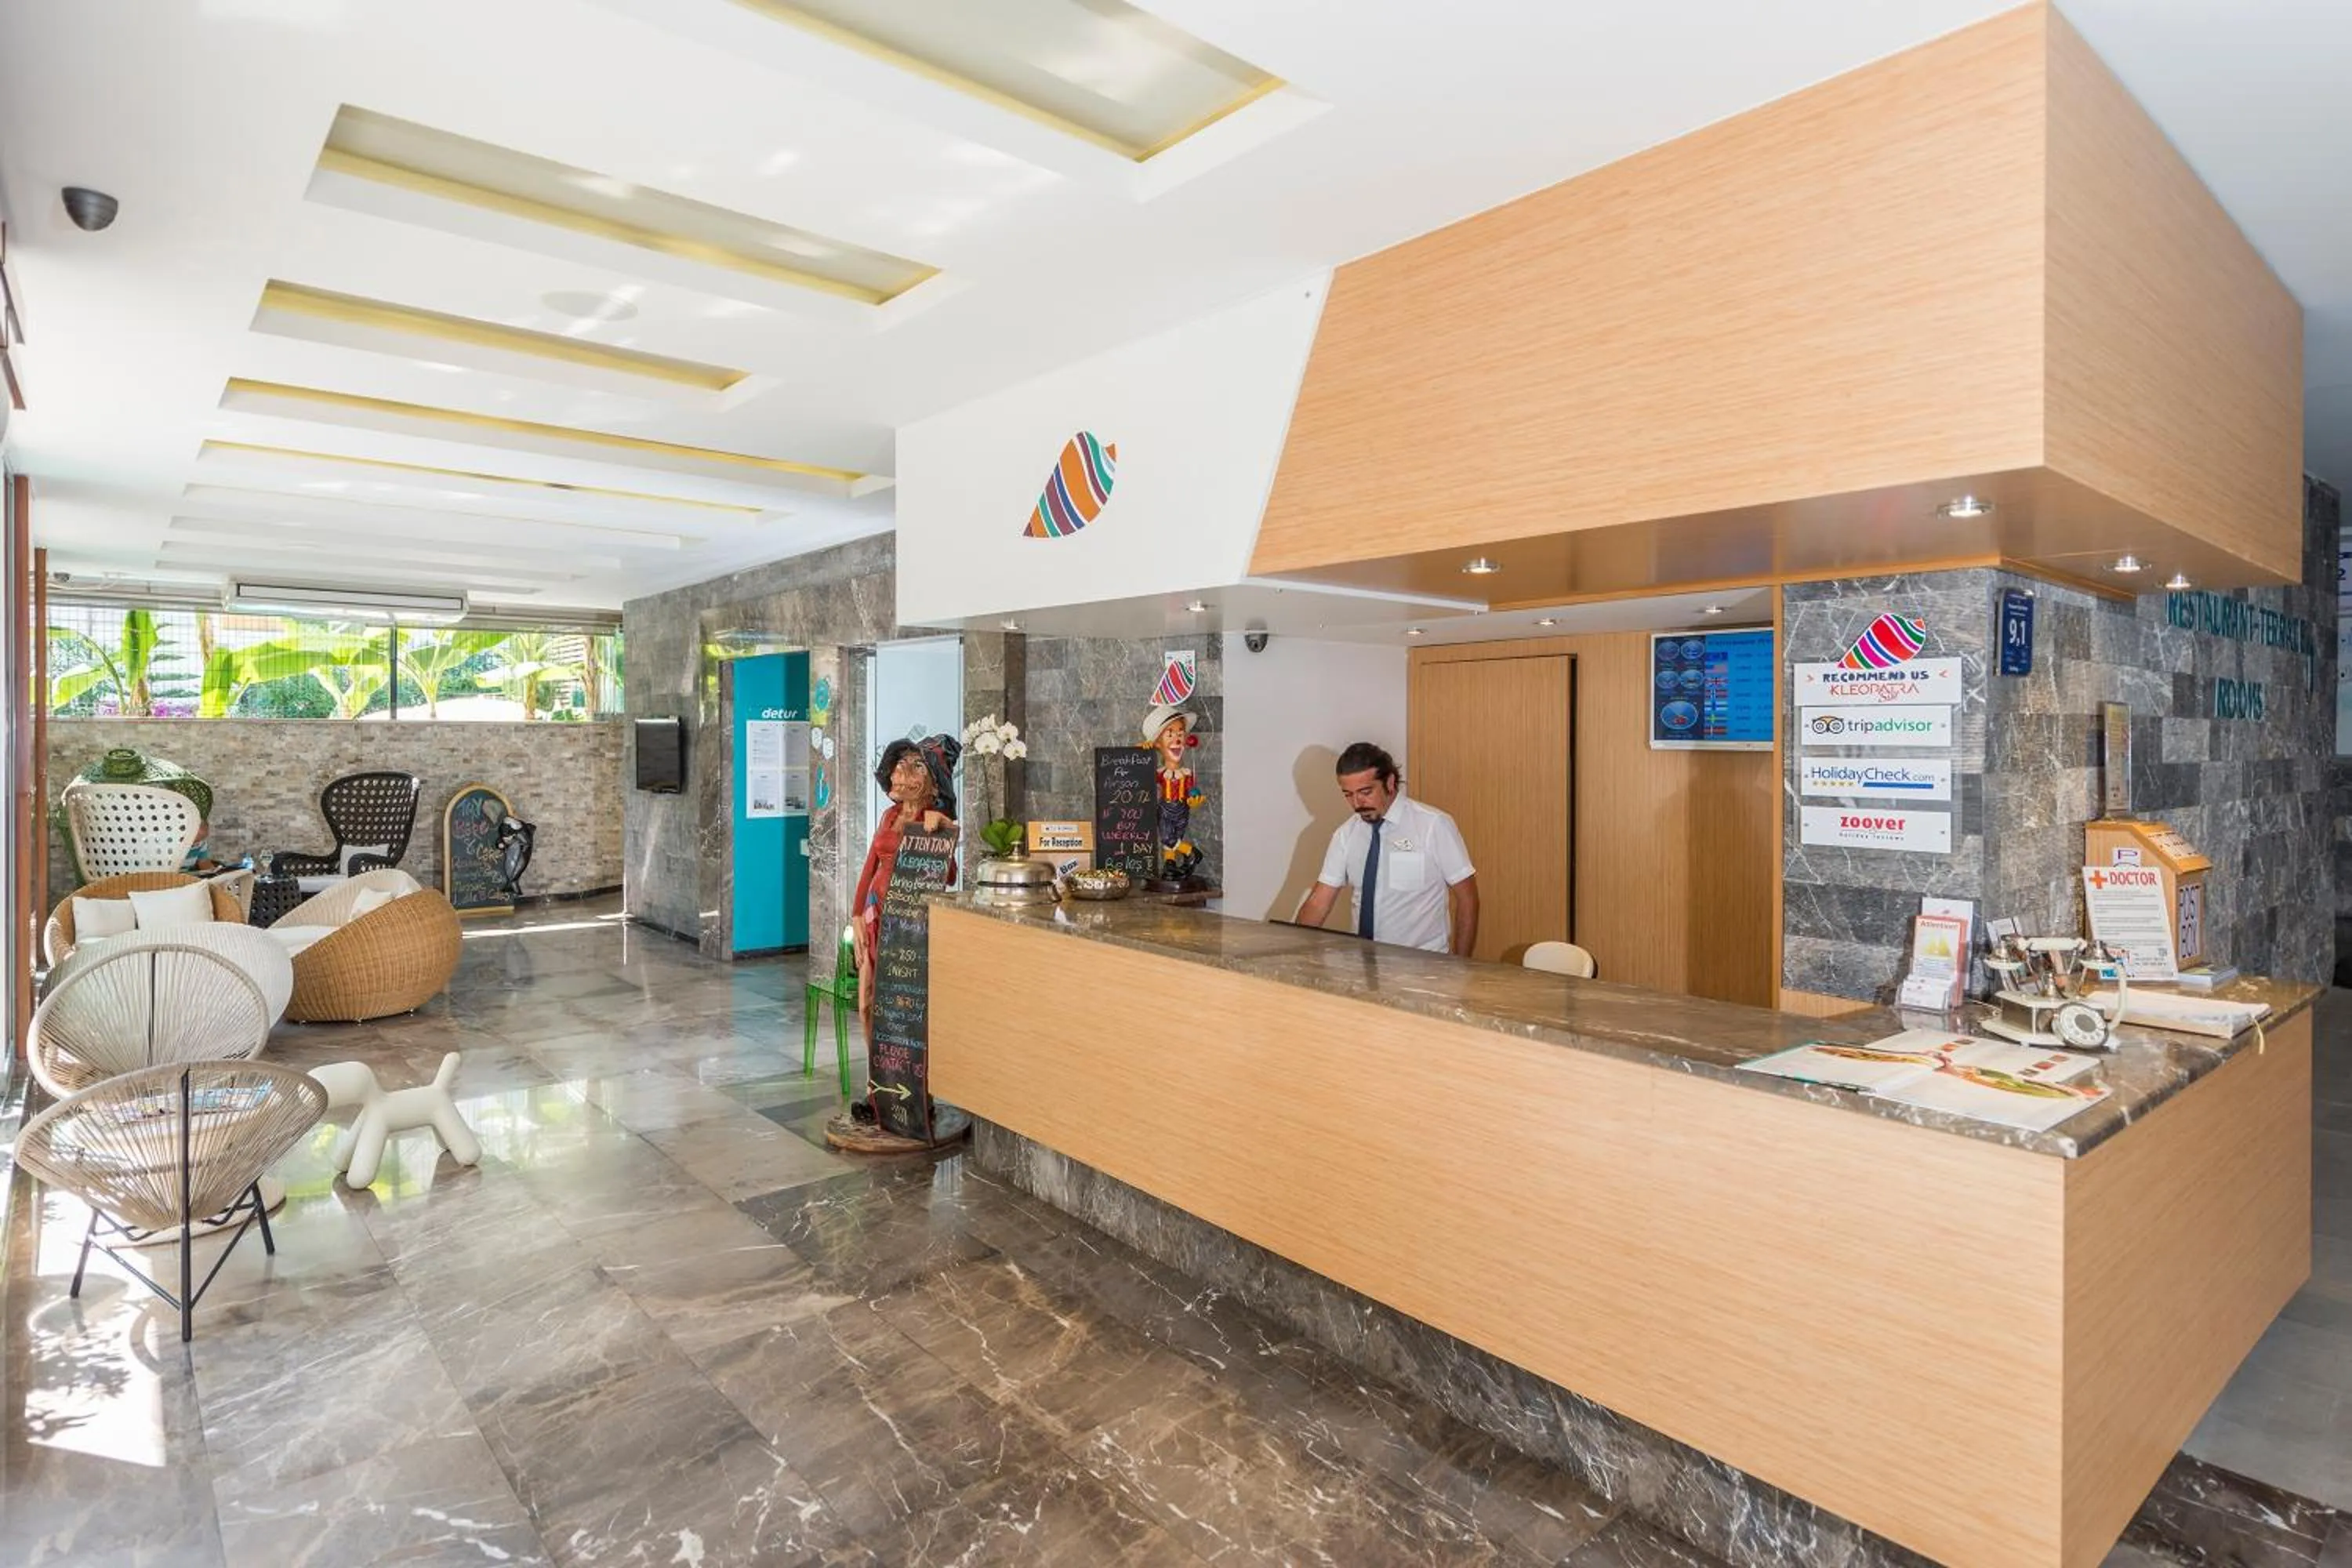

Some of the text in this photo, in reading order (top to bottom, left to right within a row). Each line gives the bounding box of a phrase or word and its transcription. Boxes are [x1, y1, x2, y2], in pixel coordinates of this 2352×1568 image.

[1822, 670, 1930, 683] RECOMMEND US
[1830, 682, 1920, 696] KLEOPATRA
[2214, 677, 2265, 722] ROOMS
[761, 707, 798, 719] detur
[1847, 717, 1933, 734] tripadvisor
[1839, 815, 1907, 831] zoover
[1051, 836, 1083, 848] Reception
[2109, 870, 2158, 886] DOCTOR
